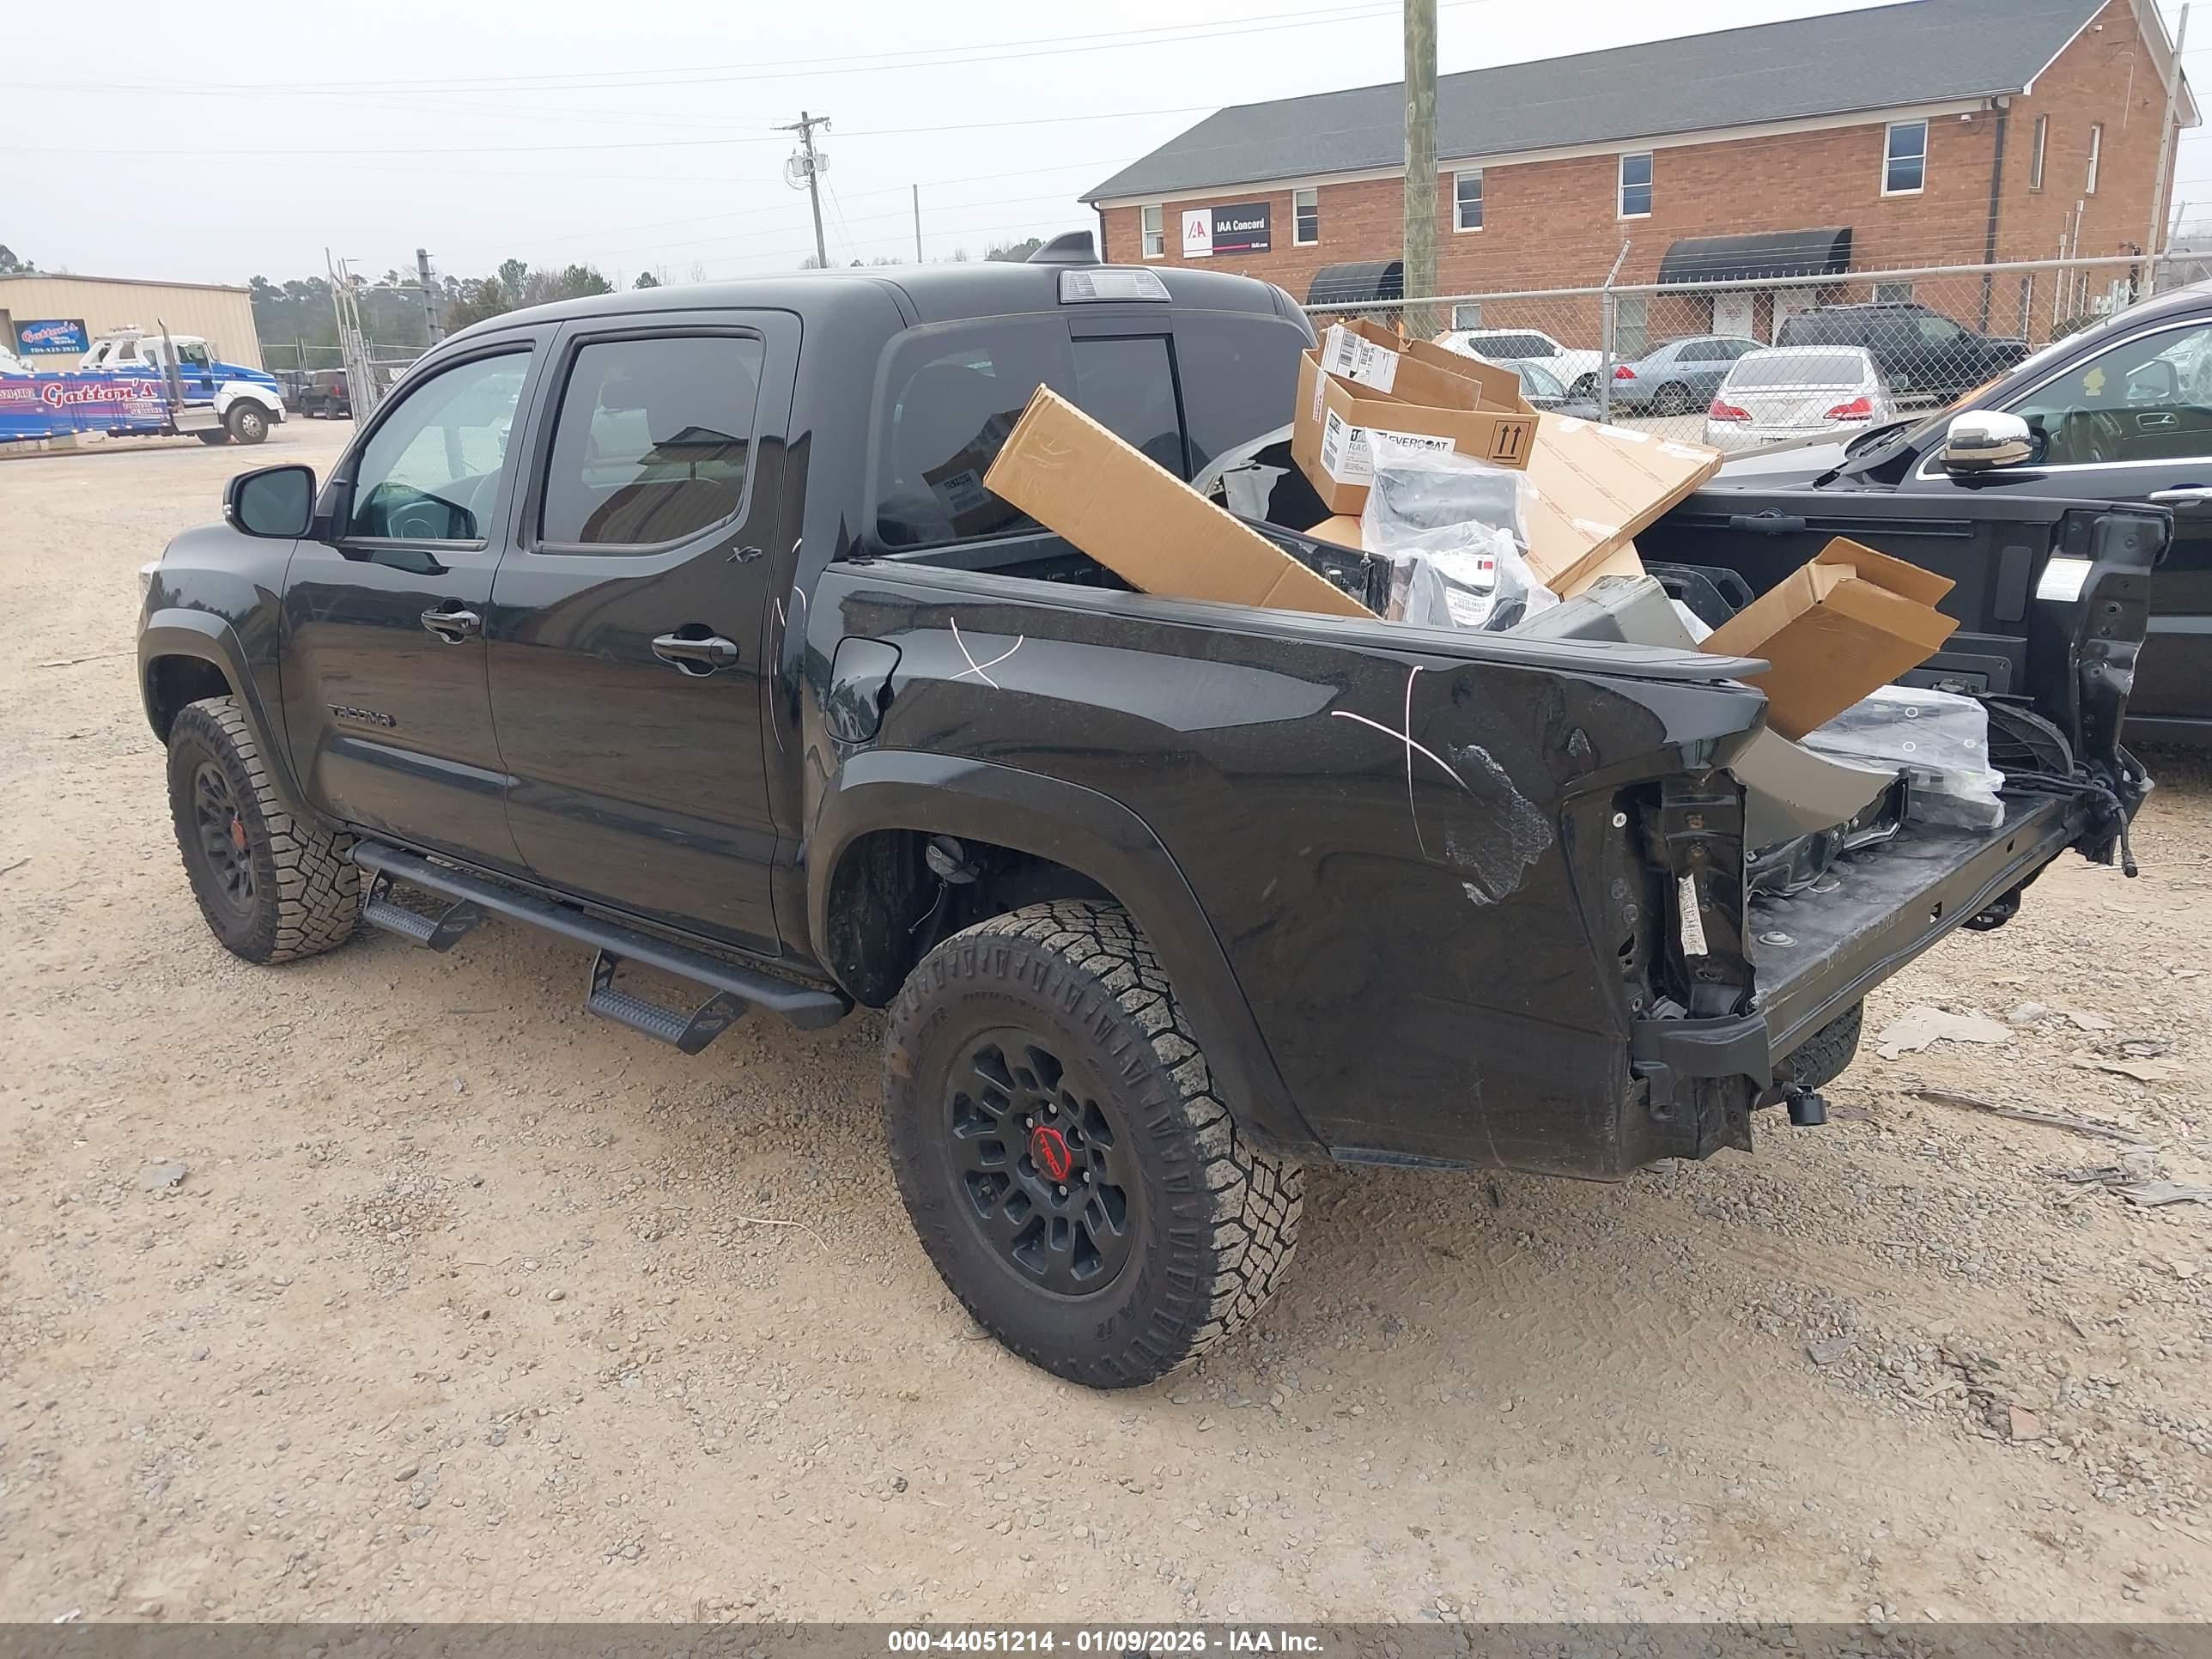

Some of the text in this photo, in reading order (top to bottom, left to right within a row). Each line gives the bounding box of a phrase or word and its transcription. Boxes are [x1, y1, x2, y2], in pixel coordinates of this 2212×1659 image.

[1217, 216, 1265, 233] IAA Concord
[21, 320, 79, 343] Gatton's
[42, 378, 157, 409] Gatton's
[1039, 1133, 1062, 1176] TRD
